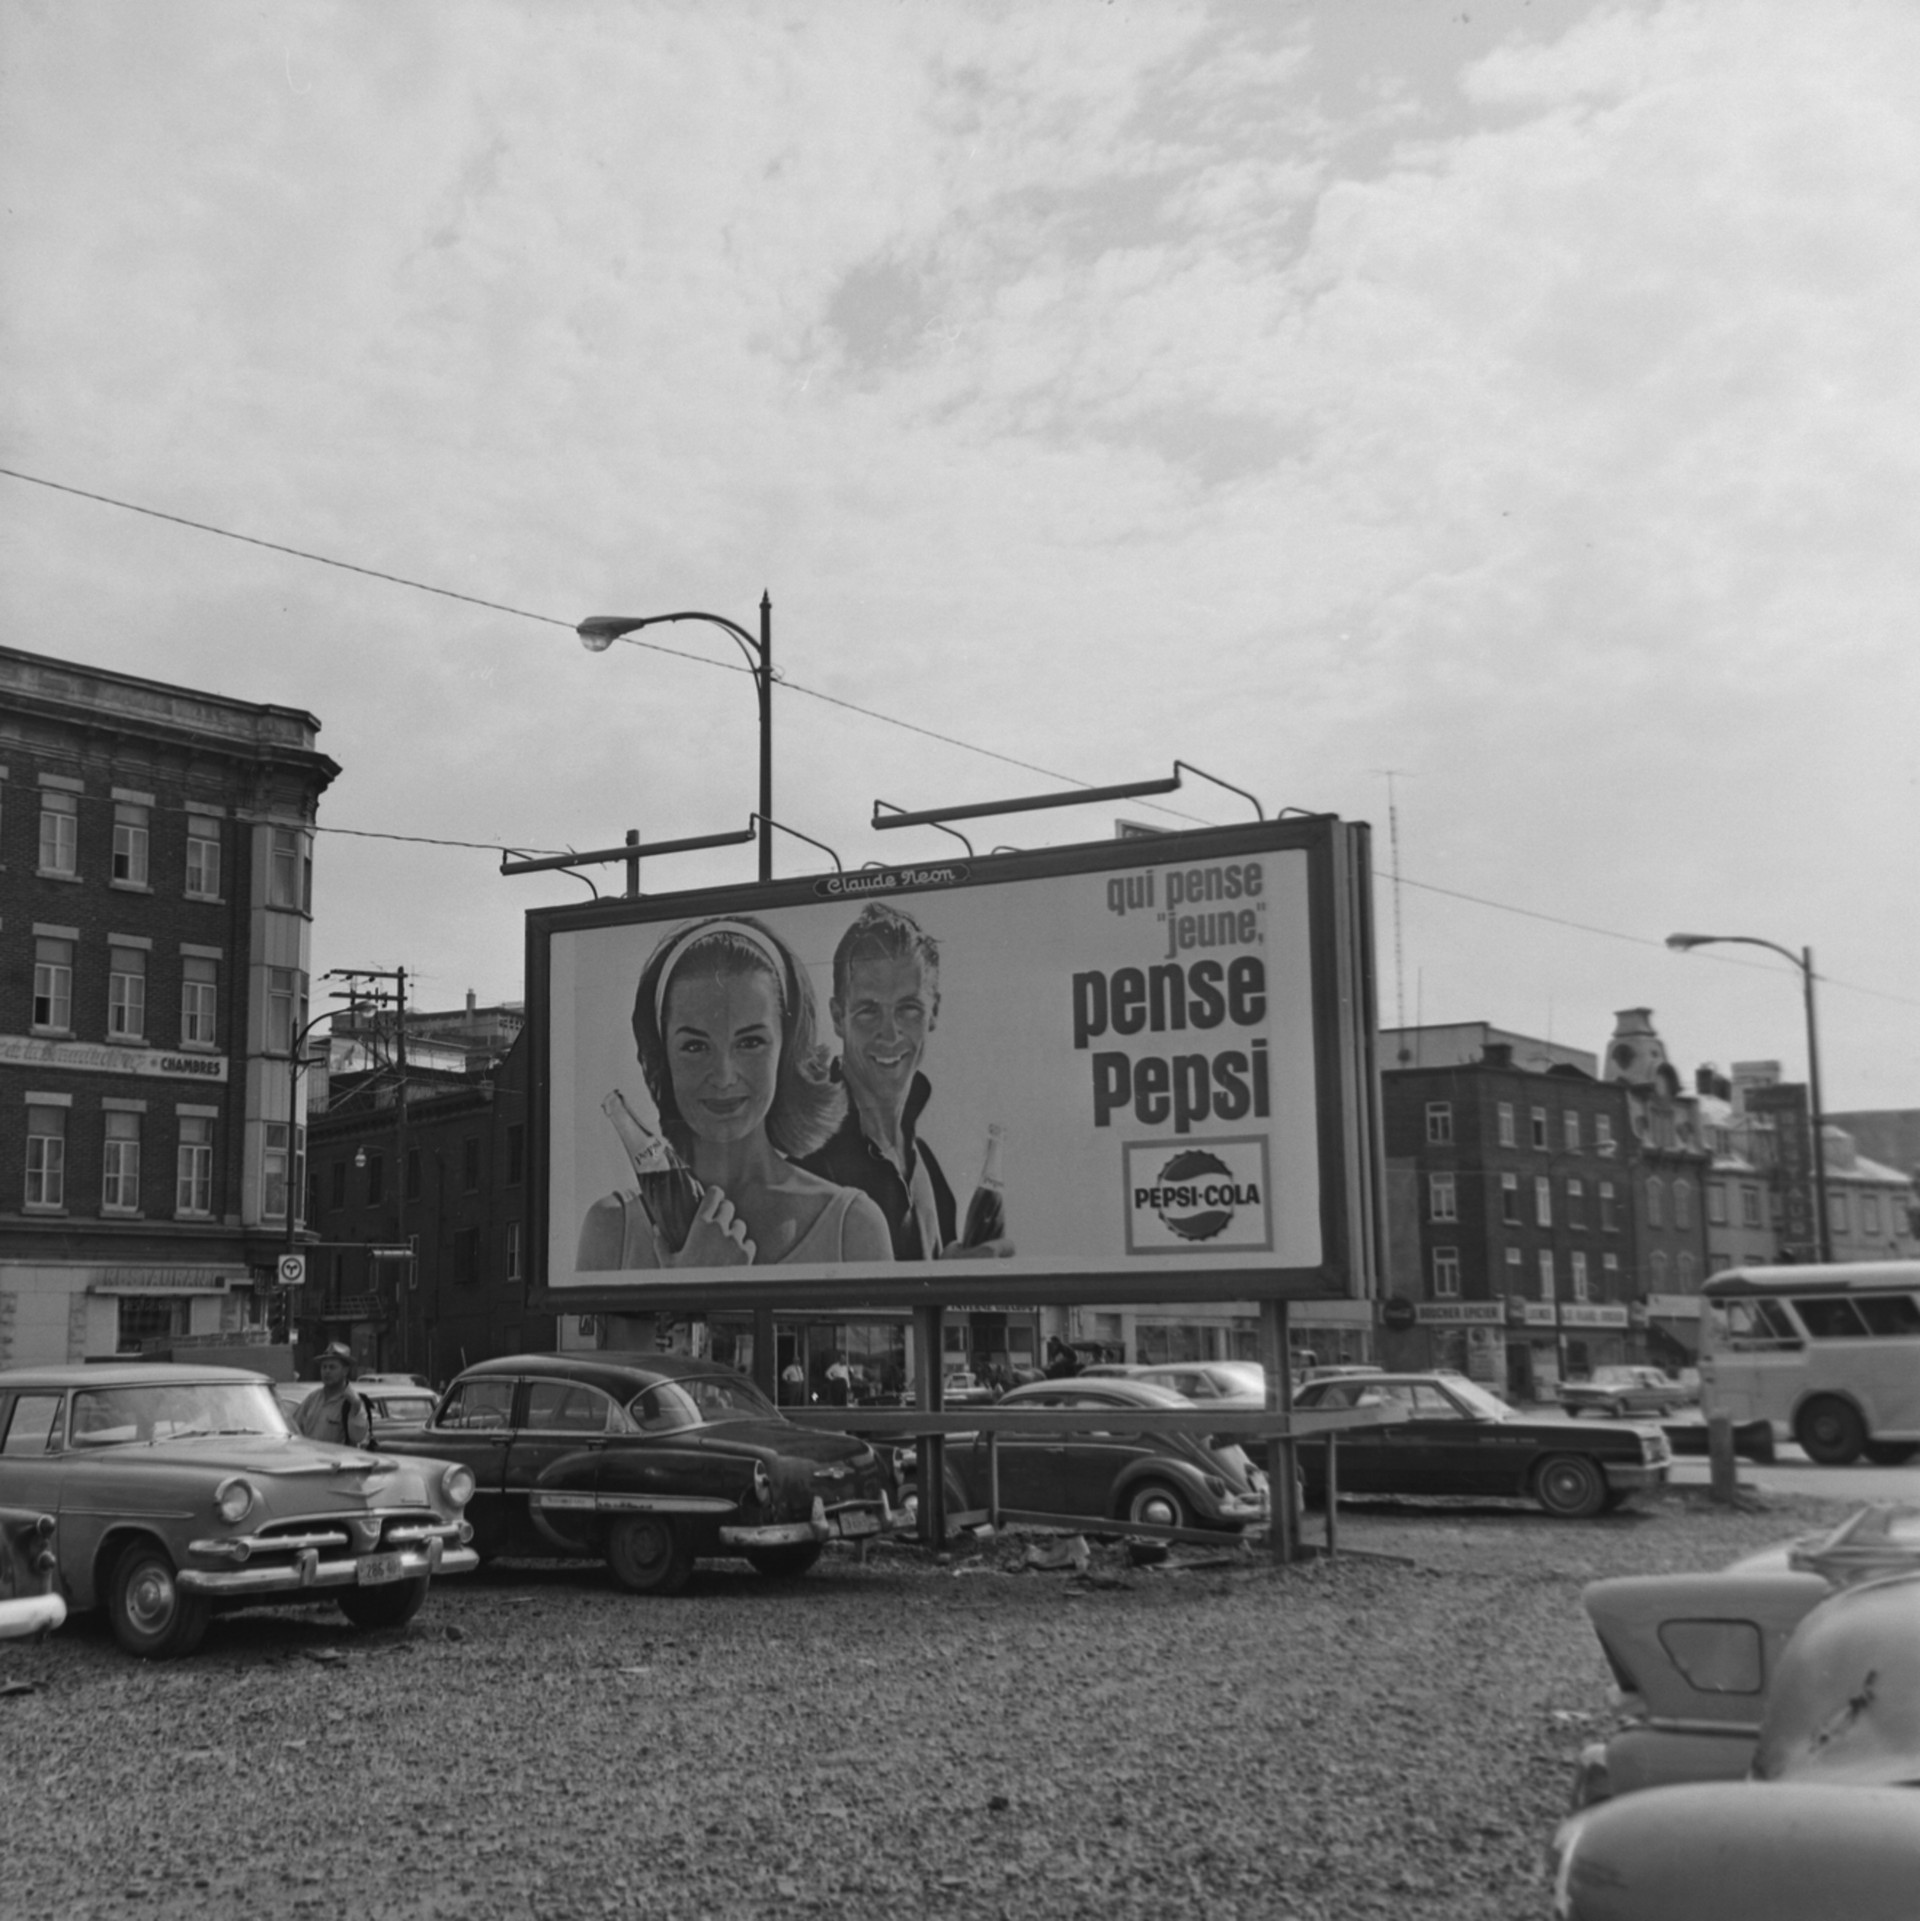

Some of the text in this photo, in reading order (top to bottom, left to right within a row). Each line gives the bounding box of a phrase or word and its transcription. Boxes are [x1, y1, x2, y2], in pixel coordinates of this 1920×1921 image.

[825, 867, 957, 894] Claude Neon
[1106, 861, 1263, 916] qui pense
[1072, 955, 1267, 1049] pense
[161, 1057, 221, 1078] CHAMBRES
[1092, 1038, 1270, 1133] Pepsi
